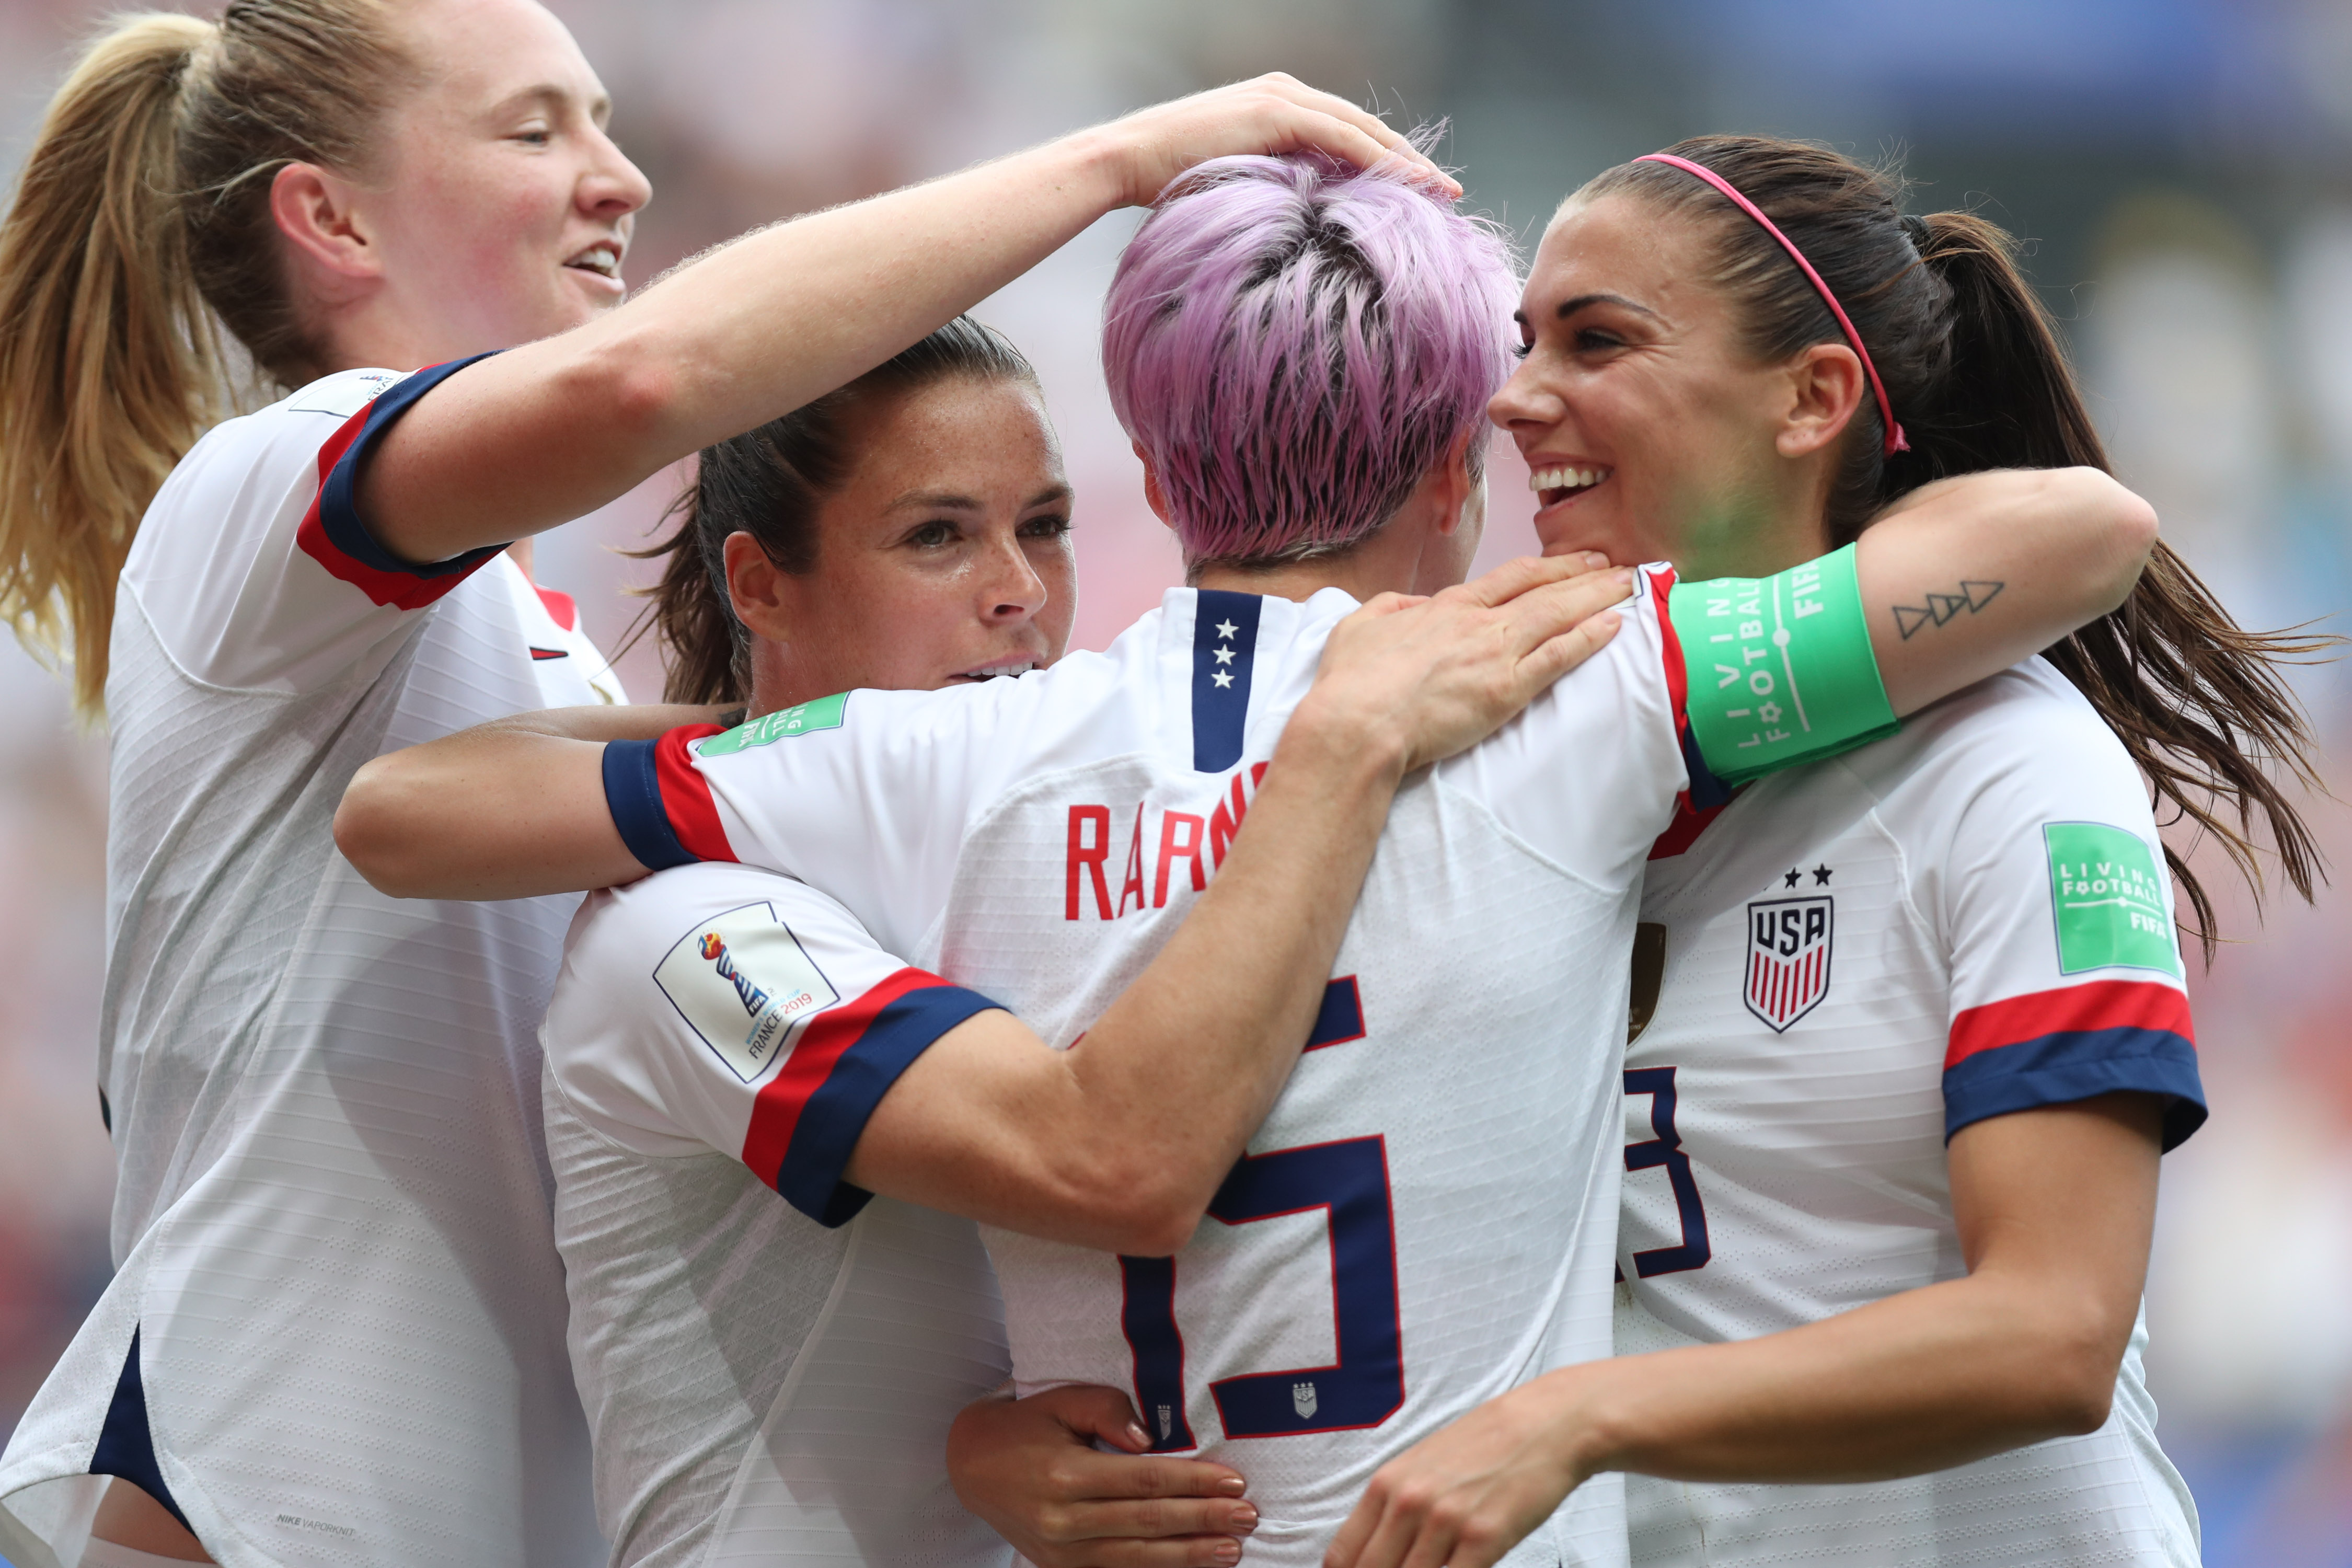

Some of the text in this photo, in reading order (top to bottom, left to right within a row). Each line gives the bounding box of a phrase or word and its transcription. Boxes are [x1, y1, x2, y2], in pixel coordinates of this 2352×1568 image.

[2060, 862, 2157, 892] LIVING
[2062, 878, 2161, 907] FOOTBALL
[1757, 906, 1825, 957] USA
[2130, 911, 2167, 940] FIFA
[748, 995, 766, 1013] FIFA
[763, 998, 785, 1016] WORLD
[787, 989, 800, 999] CUP
[748, 993, 812, 1059] FRANCE 2019
[277, 1514, 356, 1537] NIKE VAPORKNIT
